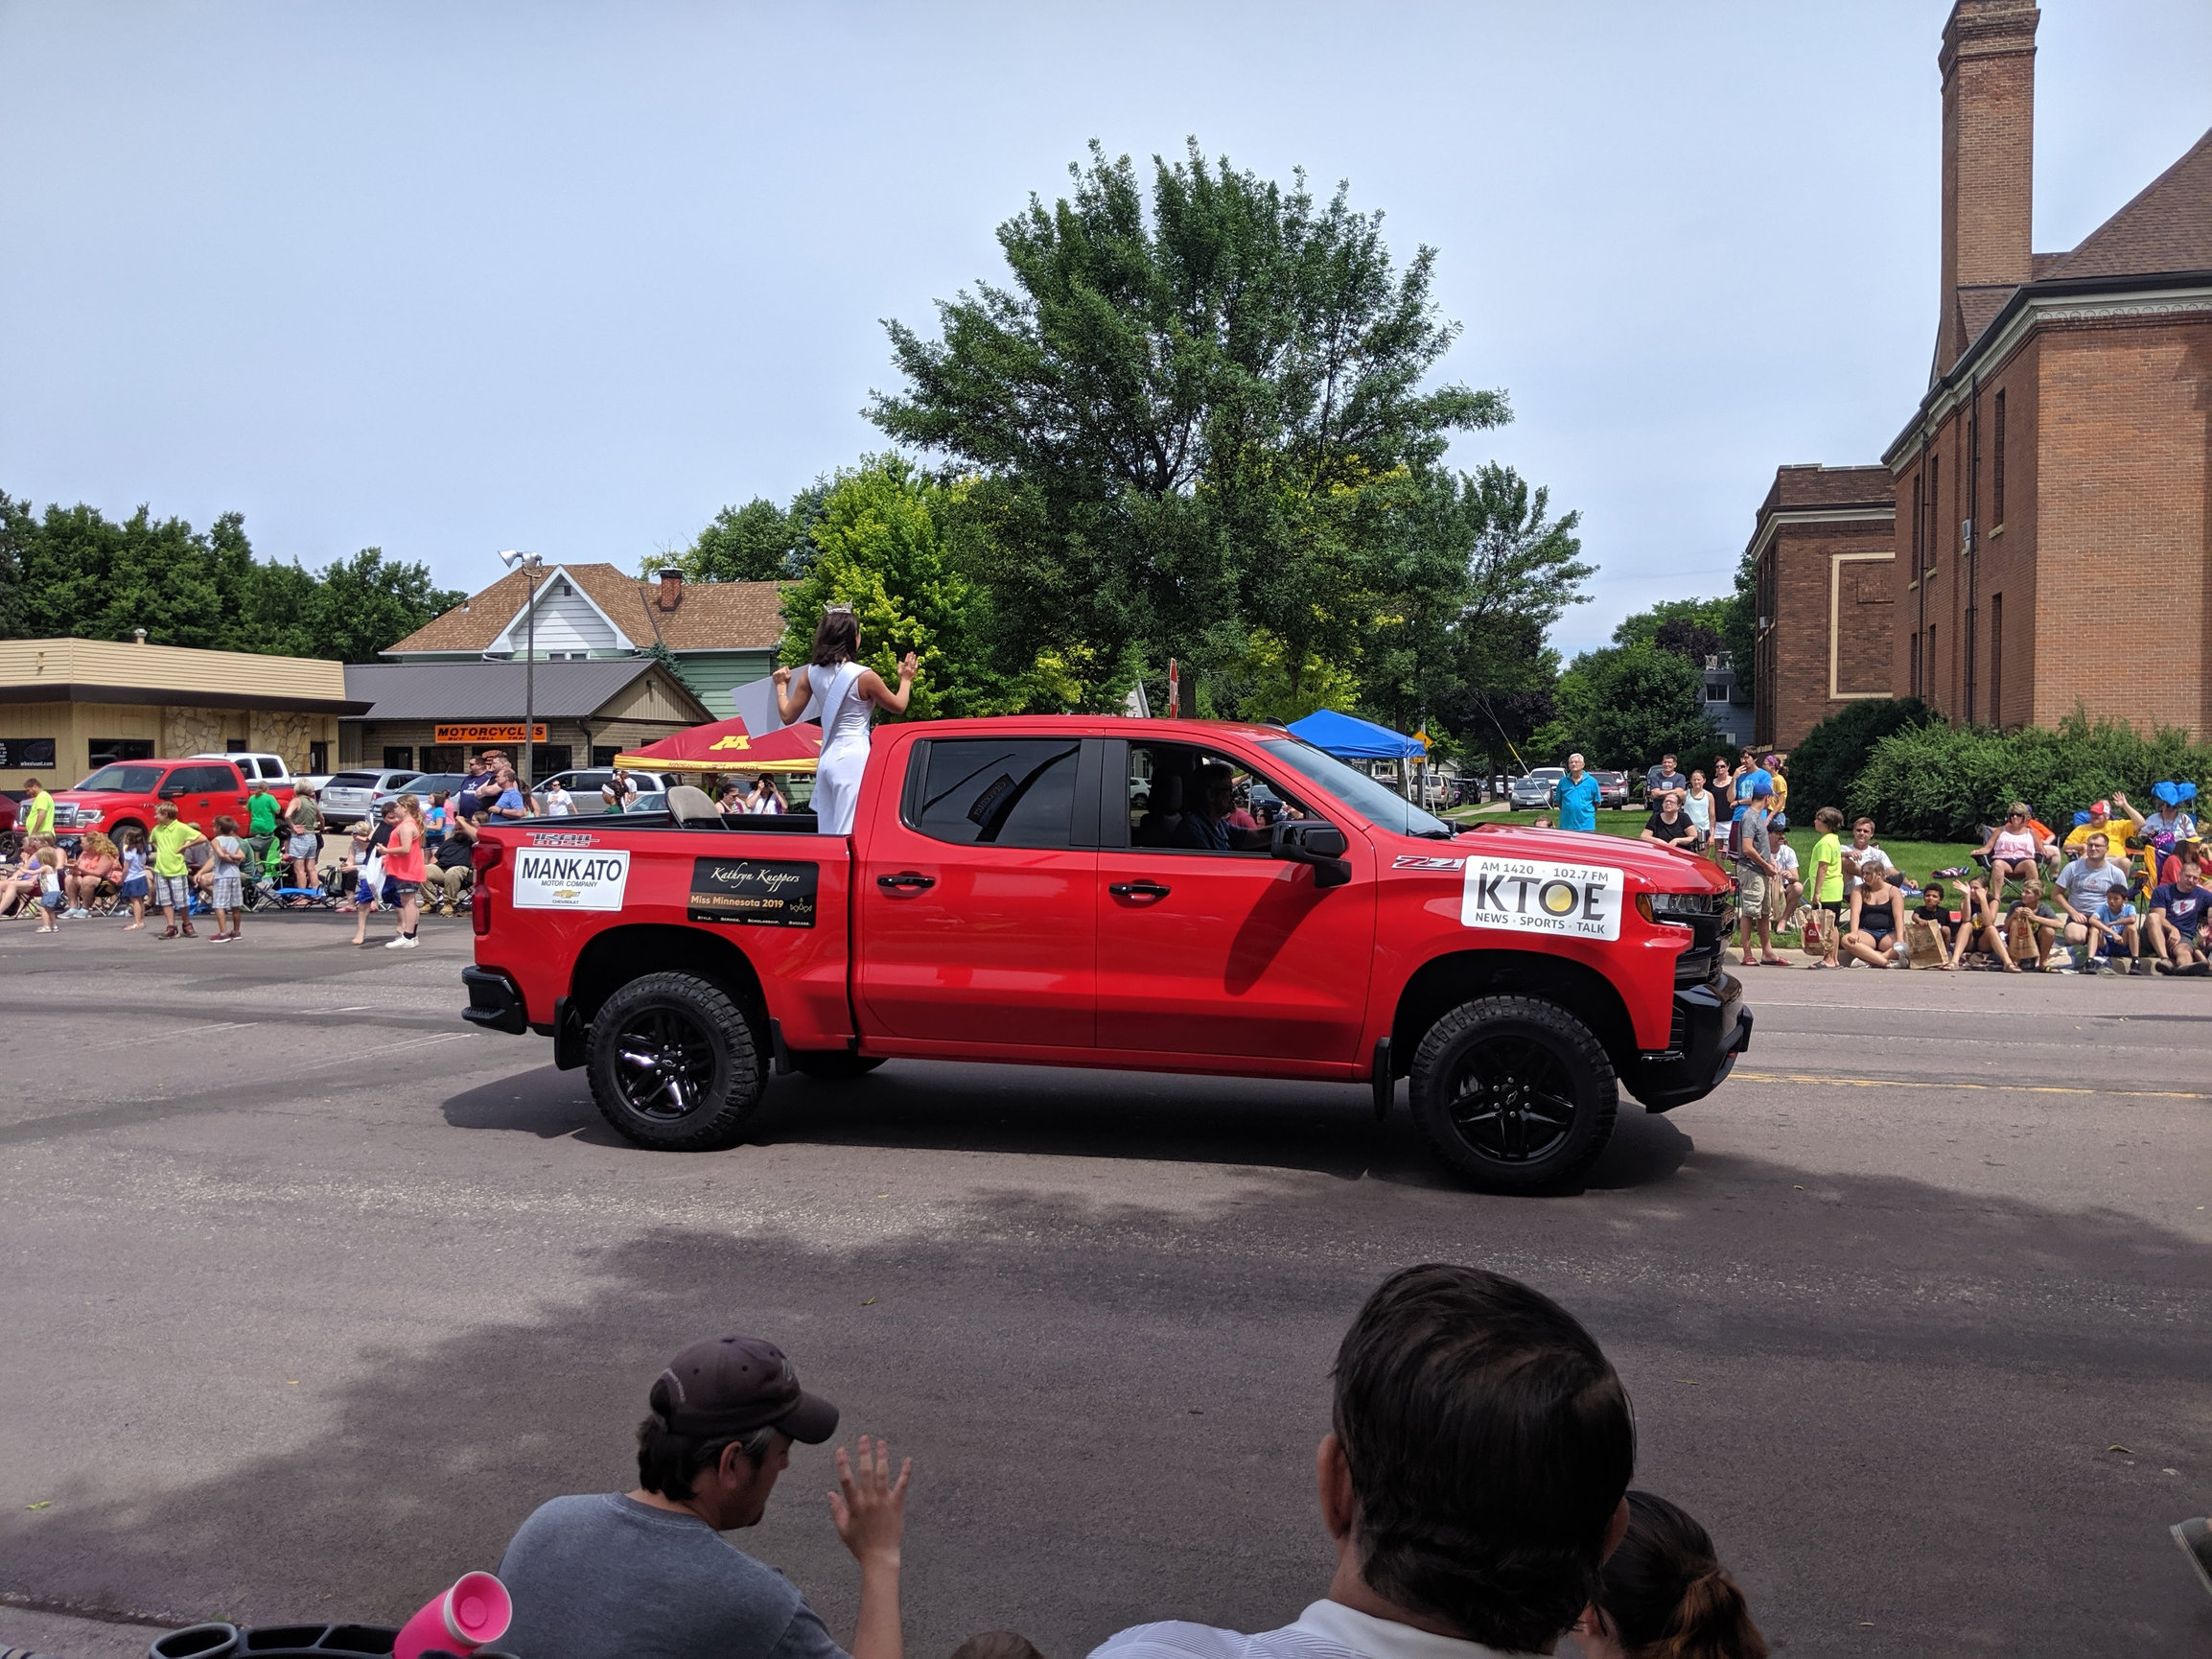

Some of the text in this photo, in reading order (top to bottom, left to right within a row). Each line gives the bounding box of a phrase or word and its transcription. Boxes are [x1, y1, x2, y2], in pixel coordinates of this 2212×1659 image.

[437, 726, 544, 736] MOTORCYCLS
[522, 857, 622, 881] MANKATO
[710, 862, 801, 892] Kathryn Kueppers
[1480, 861, 1609, 882] AM 1420 102.7 FM
[690, 895, 784, 908] Miss Minnesota 2019
[1477, 873, 1607, 922] KTOE
[1475, 912, 1605, 934] NEWS SPORTS TALK
